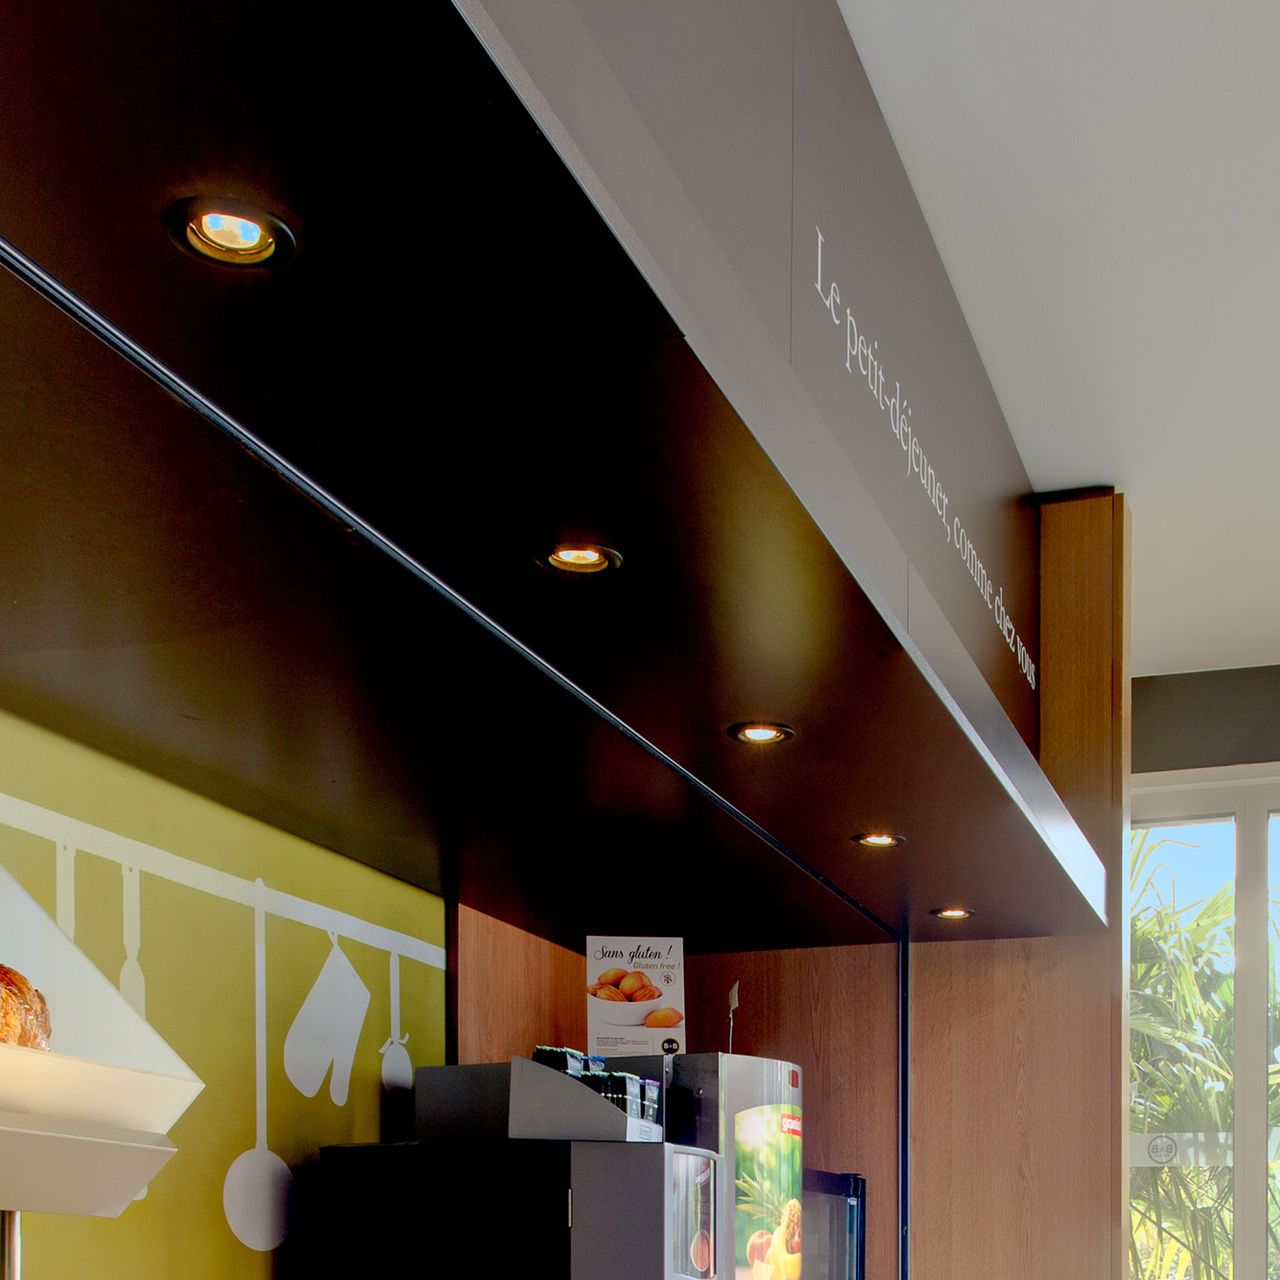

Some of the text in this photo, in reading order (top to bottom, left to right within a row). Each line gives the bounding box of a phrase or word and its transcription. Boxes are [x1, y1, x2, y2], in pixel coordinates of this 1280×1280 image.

[815, 225, 1037, 691] Le petit-déjeuner, comme chez vous
[594, 945, 624, 961] Sans
[627, 944, 662, 964] gluten
[633, 961, 658, 970] Gluten
[660, 961, 675, 970] free
